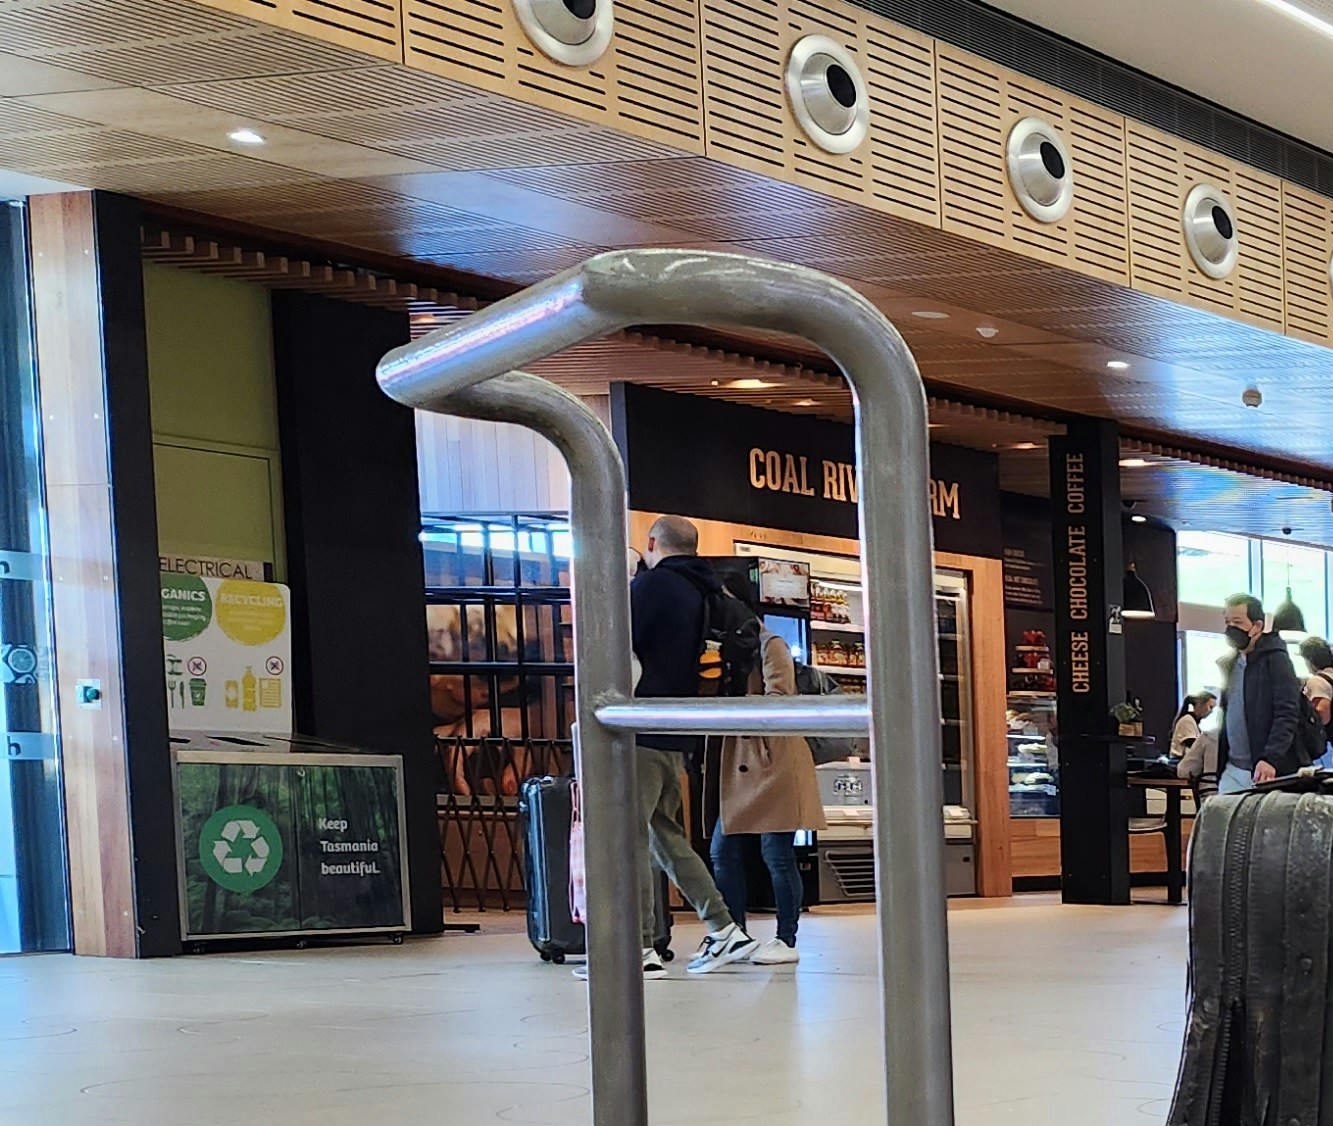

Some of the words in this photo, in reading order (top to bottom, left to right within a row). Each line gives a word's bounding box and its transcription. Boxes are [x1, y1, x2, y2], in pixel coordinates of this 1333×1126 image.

[749, 448, 815, 496] COAL
[822, 459, 859, 503] RIV
[929, 478, 961, 519] RM
[1065, 453, 1084, 513] COFFEE
[159, 557, 252, 579] ELECTRICAL
[1068, 525, 1088, 620] CHOCOLATE
[161, 588, 206, 602] GANICS
[1071, 631, 1090, 693] CHEESE
[319, 818, 348, 832] Keep
[320, 838, 378, 852] Tasmania
